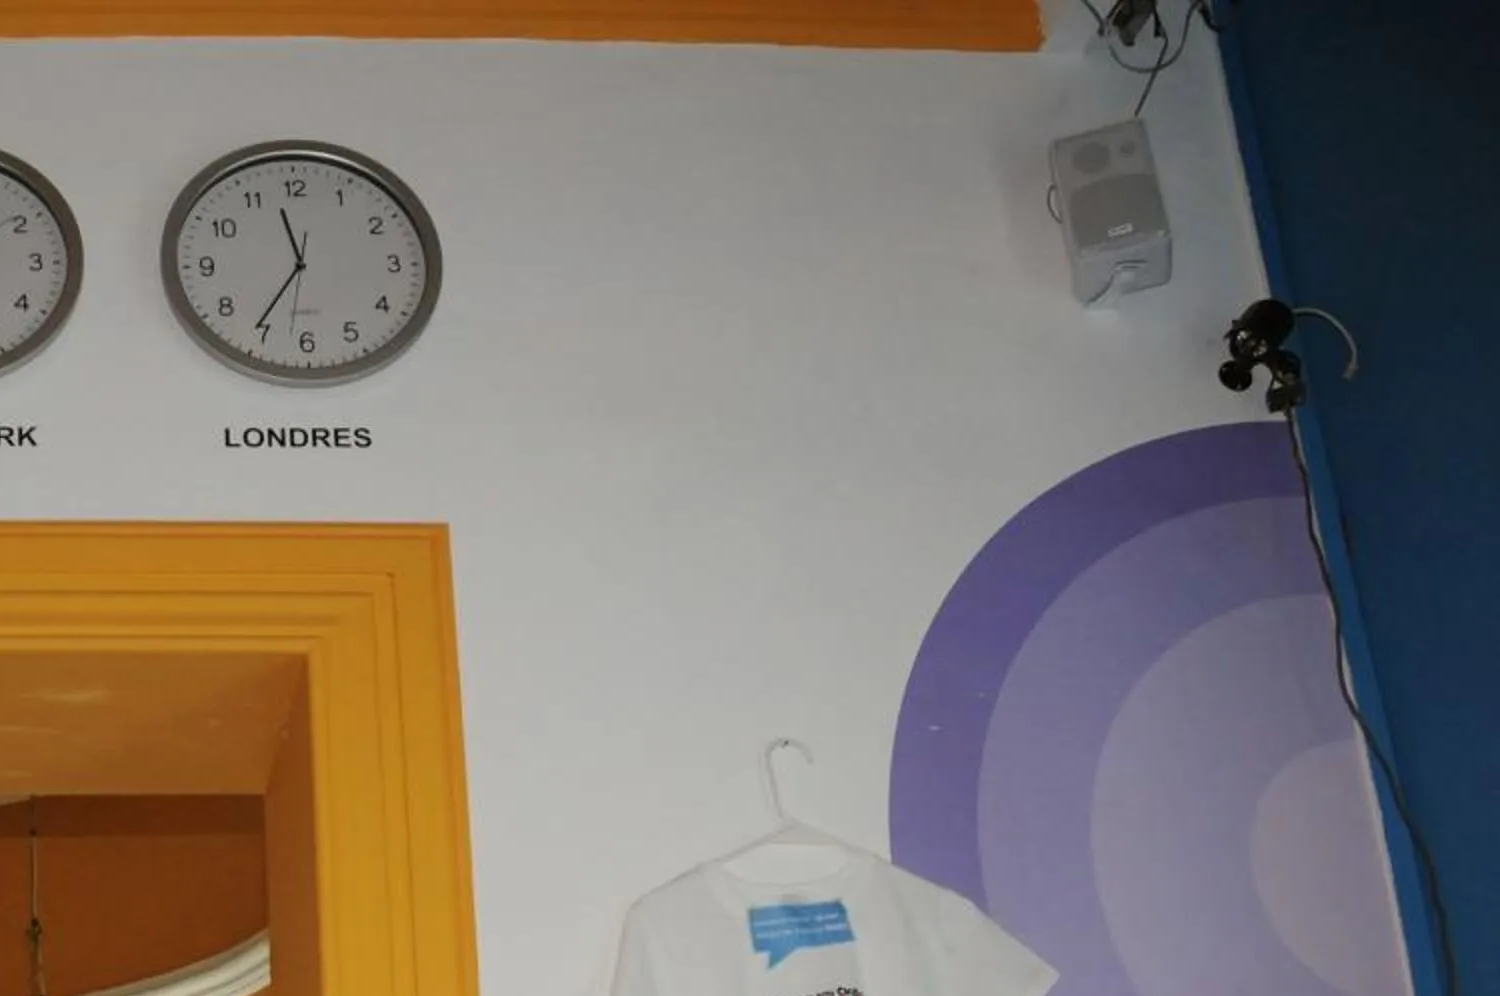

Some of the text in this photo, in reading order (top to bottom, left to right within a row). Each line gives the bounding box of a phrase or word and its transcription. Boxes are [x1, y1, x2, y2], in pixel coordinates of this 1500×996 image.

[284, 179, 307, 198] 12
[335, 189, 344, 207] 1
[243, 191, 261, 209] 11
[11, 214, 28, 234] 2
[211, 217, 237, 239] 10
[368, 216, 384, 236] 2
[29, 252, 43, 272] 3
[198, 255, 215, 277] 9
[387, 254, 402, 273] 3
[13, 293, 29, 312] 4
[218, 296, 235, 317] 8
[375, 295, 390, 313] 4
[299, 331, 316, 354] 6
[343, 321, 360, 344] 5
[224, 427, 373, 449] LONDRES
